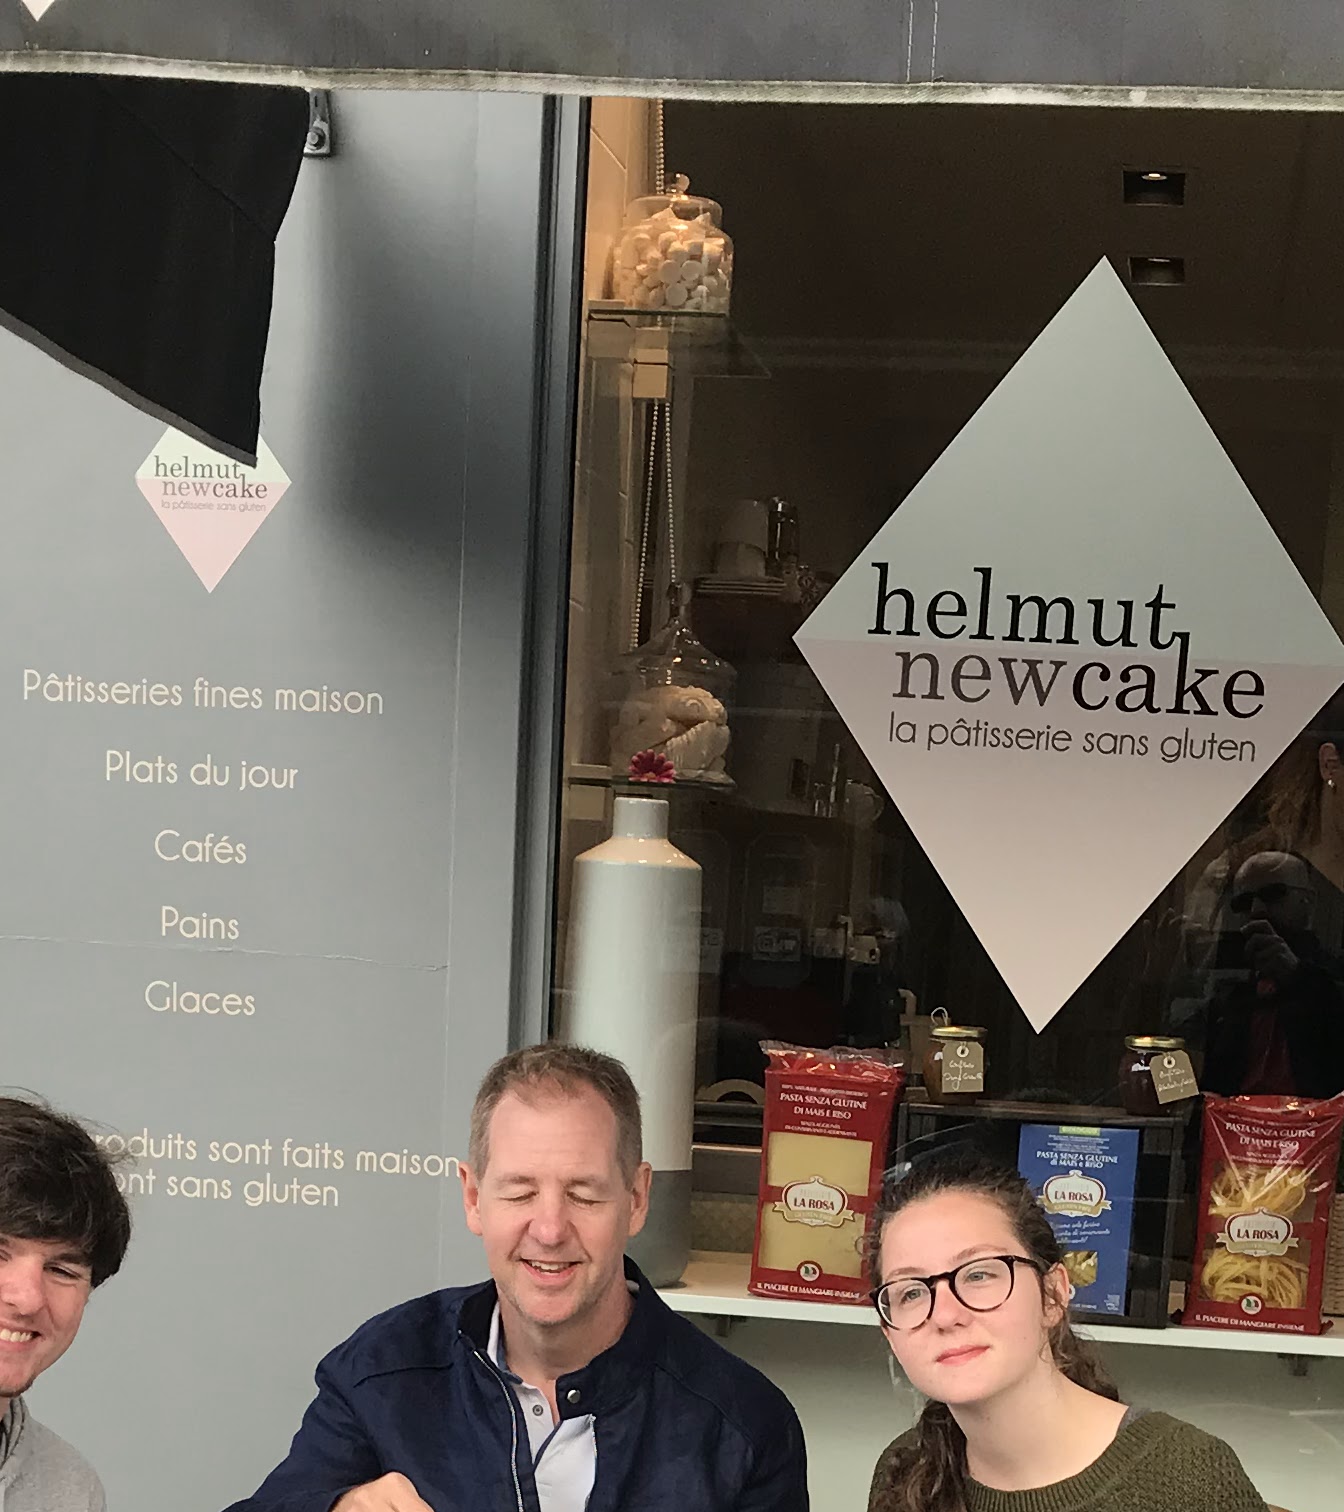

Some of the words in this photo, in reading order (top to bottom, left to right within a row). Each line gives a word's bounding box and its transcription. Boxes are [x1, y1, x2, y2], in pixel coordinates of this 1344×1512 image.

[154, 455, 244, 480] helmut
[162, 474, 267, 499] newcake
[867, 562, 1182, 650] helmut
[23, 669, 183, 706] Pâtisseries
[193, 677, 263, 710] fines
[275, 685, 384, 715] maison
[892, 632, 1265, 719] newcake
[889, 711, 916, 743] la
[927, 719, 1072, 751] pâtisserie
[1083, 728, 1149, 756] sans
[1160, 727, 1256, 764] gluten
[106, 750, 178, 784] Plats
[189, 754, 230, 786] du
[239, 760, 299, 791] jour
[154, 829, 247, 864] Cafés
[161, 905, 240, 940] Pains
[144, 980, 256, 1015] Glaces
[780, 1093, 803, 1103] PASTA
[94, 1128, 197, 1160] roduits
[209, 1138, 272, 1165] sont
[283, 1138, 345, 1170] faits
[356, 1148, 461, 1178] maison
[115, 1168, 156, 1195] ont
[166, 1175, 232, 1200] sans
[244, 1173, 339, 1208] gluten
[794, 1197, 806, 1208] LA
[808, 1198, 834, 1211] ROSA
[1068, 1191, 1094, 1202] ROSA
[1237, 1229, 1249, 1239] LA
[1252, 1230, 1279, 1240] ROSA
